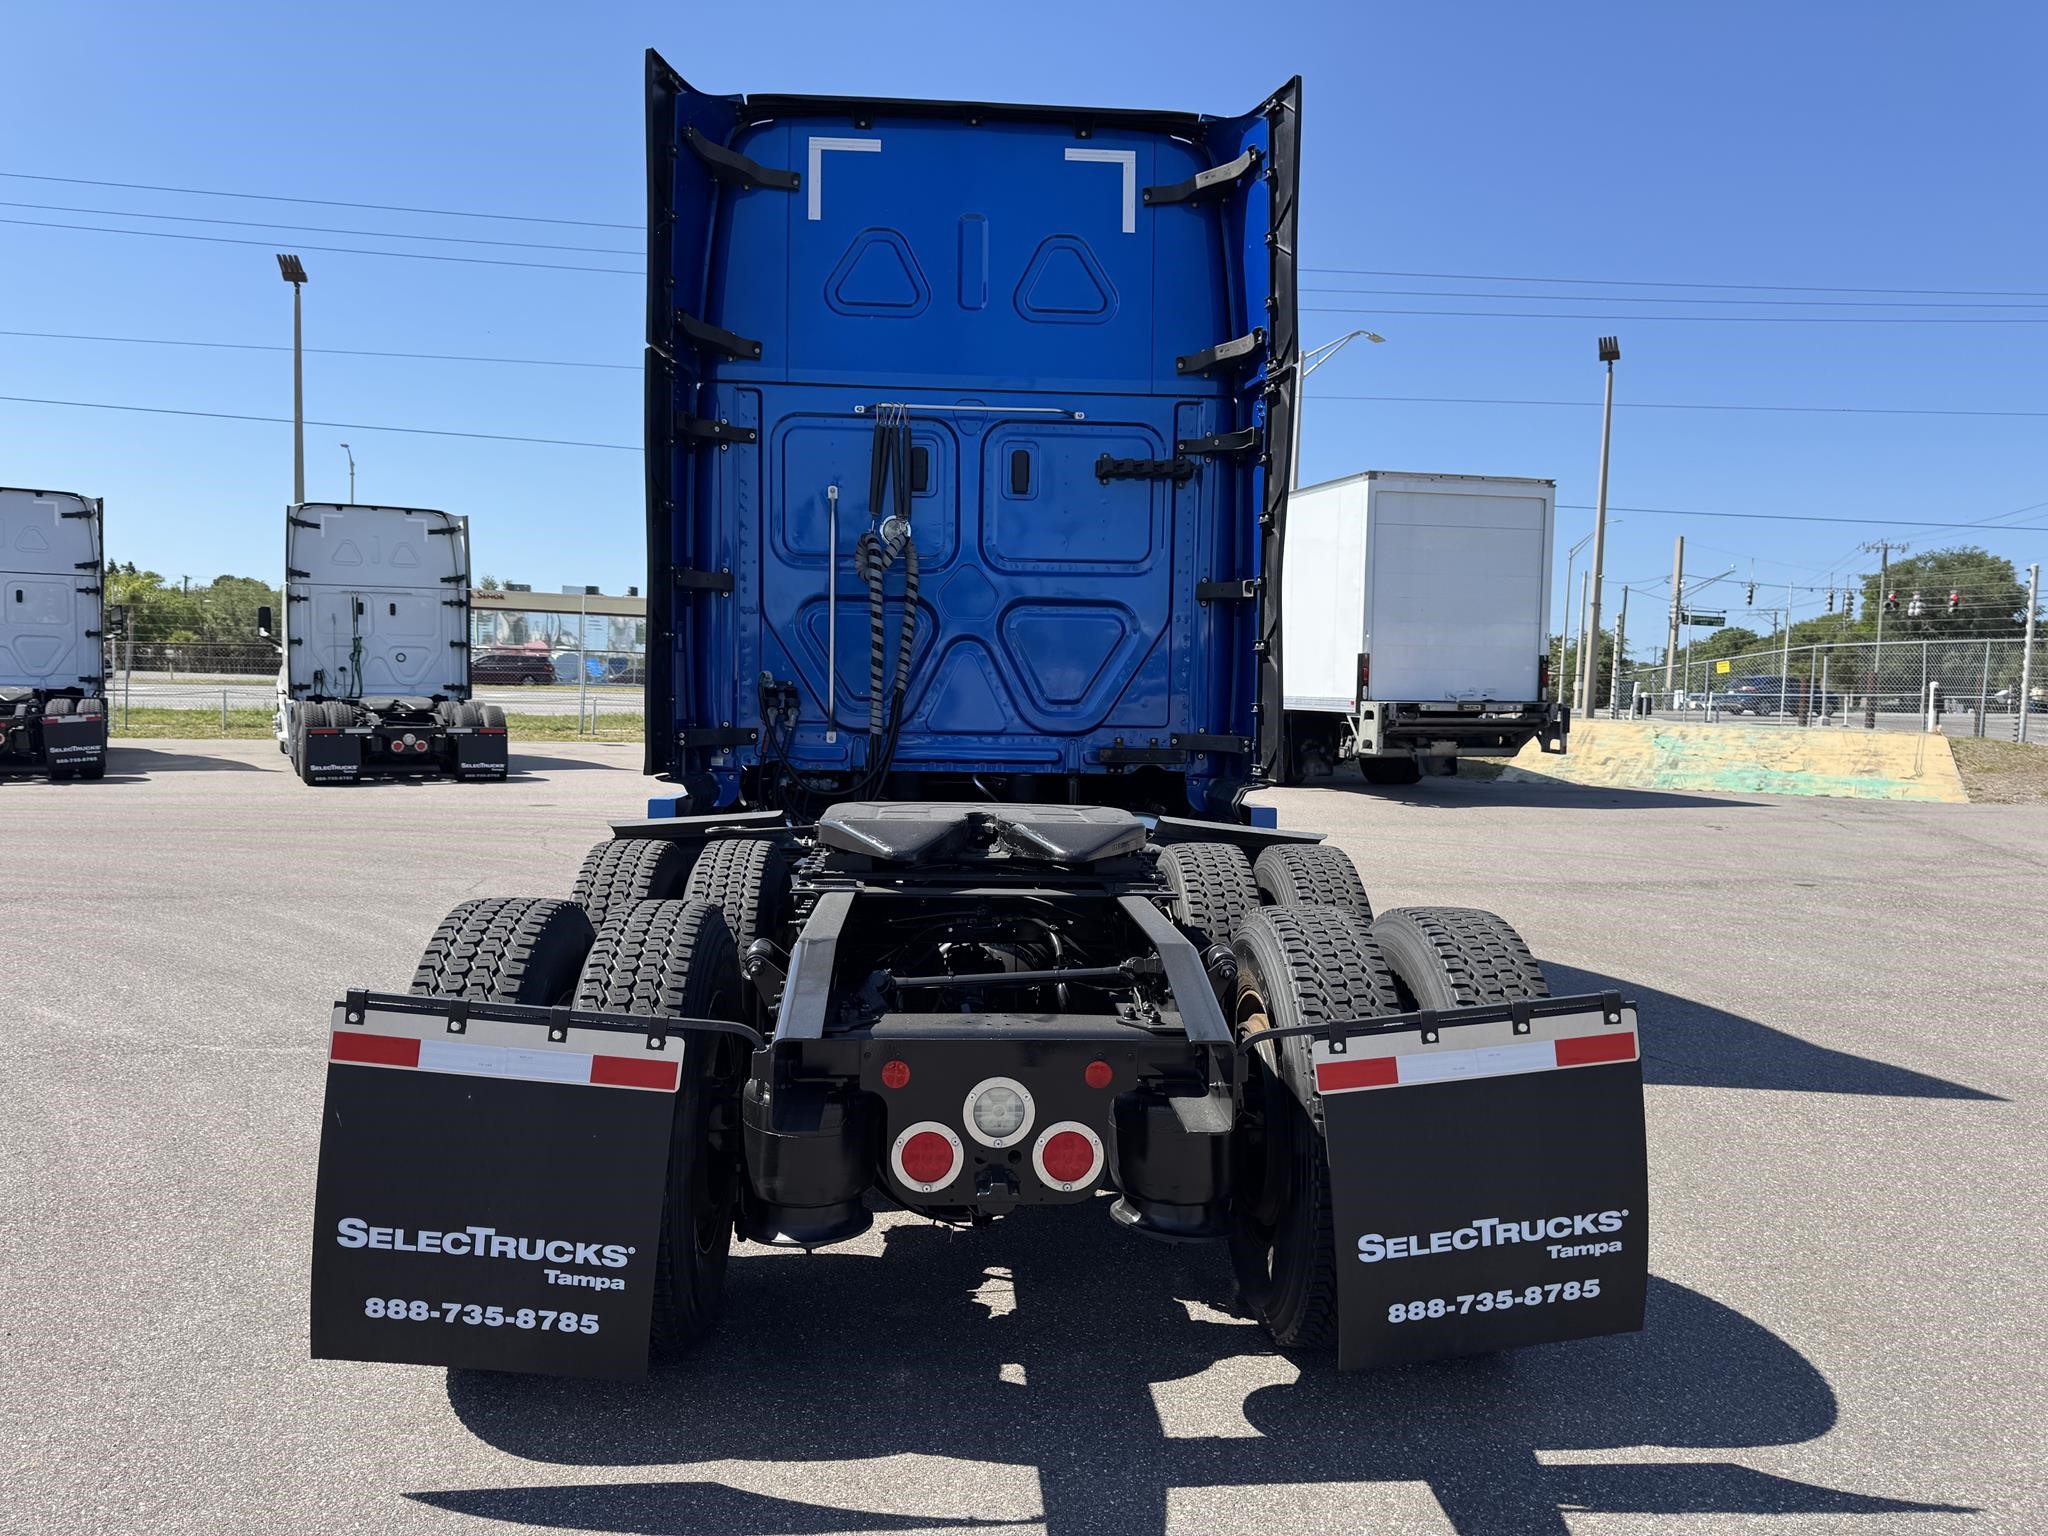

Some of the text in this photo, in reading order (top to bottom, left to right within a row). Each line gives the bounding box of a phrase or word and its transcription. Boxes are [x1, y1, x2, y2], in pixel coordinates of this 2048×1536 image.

[1547, 1241, 1623, 1260] Tampa
[544, 1269, 626, 1292] Tampa
[365, 1297, 600, 1335] 888-735-8785
[1387, 1279, 1601, 1324] 888-735-8785
